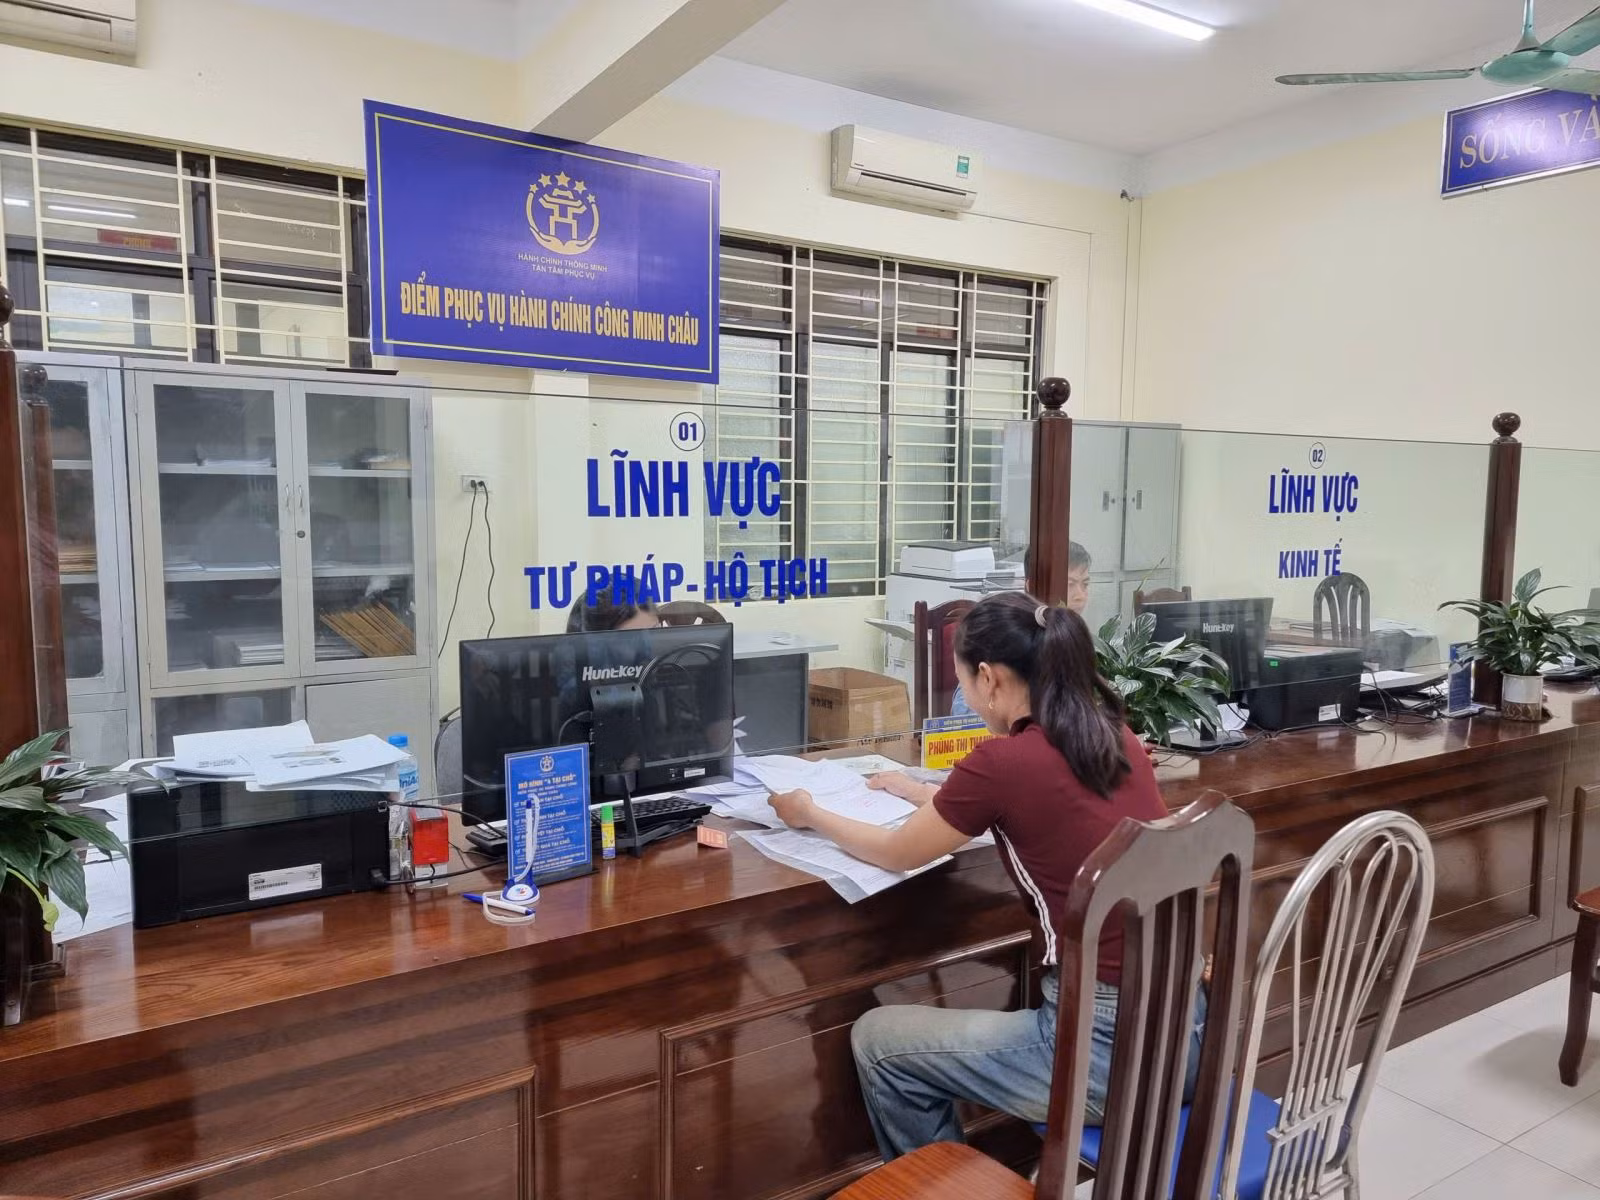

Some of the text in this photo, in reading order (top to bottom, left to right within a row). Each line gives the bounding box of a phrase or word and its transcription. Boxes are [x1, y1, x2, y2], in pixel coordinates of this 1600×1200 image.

[1459, 112, 1547, 169] SỐNG
[590, 263, 608, 272] MINH
[400, 271, 699, 346] ĐIỂM PHỤC VỤ HÀNH CHÍNH CÔNG MINH CHÂU
[678, 421, 698, 442] 01
[1312, 449, 1323, 463] 02
[586, 449, 781, 530] LĨNH VỰC
[1268, 467, 1359, 522] LĨNH VỰC
[524, 561, 577, 610] TƯ
[759, 557, 829, 605] TỊCH
[1278, 538, 1343, 579] KINH TẾ
